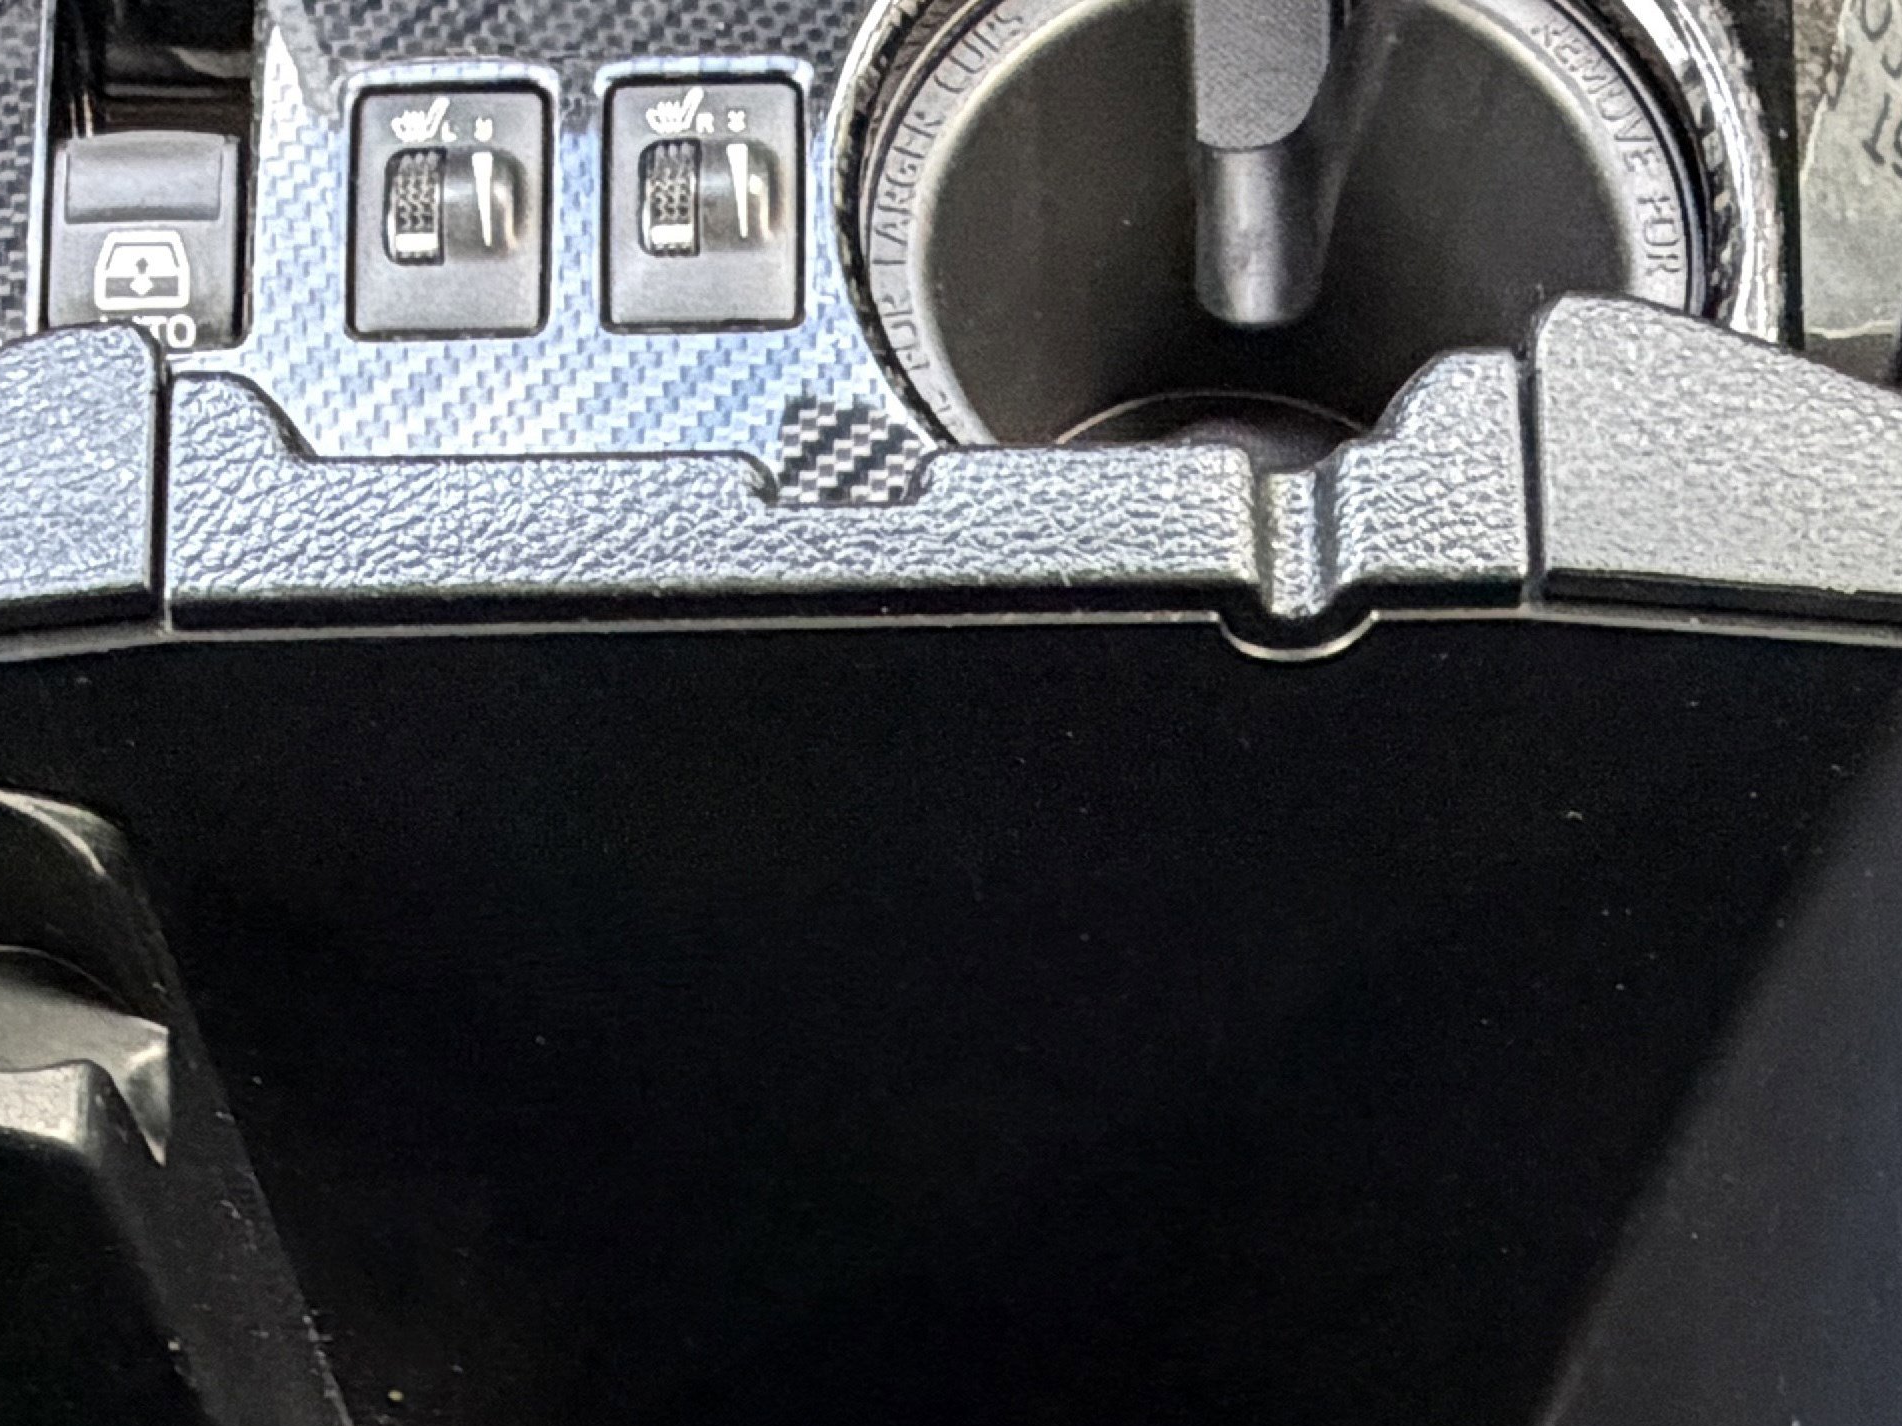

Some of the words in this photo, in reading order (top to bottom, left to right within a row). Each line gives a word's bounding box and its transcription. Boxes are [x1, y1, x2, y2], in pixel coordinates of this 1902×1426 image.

[441, 121, 458, 142] L
[696, 112, 715, 133] R
[871, 110, 946, 266] LARGER
[933, 12, 1025, 95] CUPS
[1530, 20, 1657, 173] REMOVE
[1636, 193, 1682, 277] FOR
